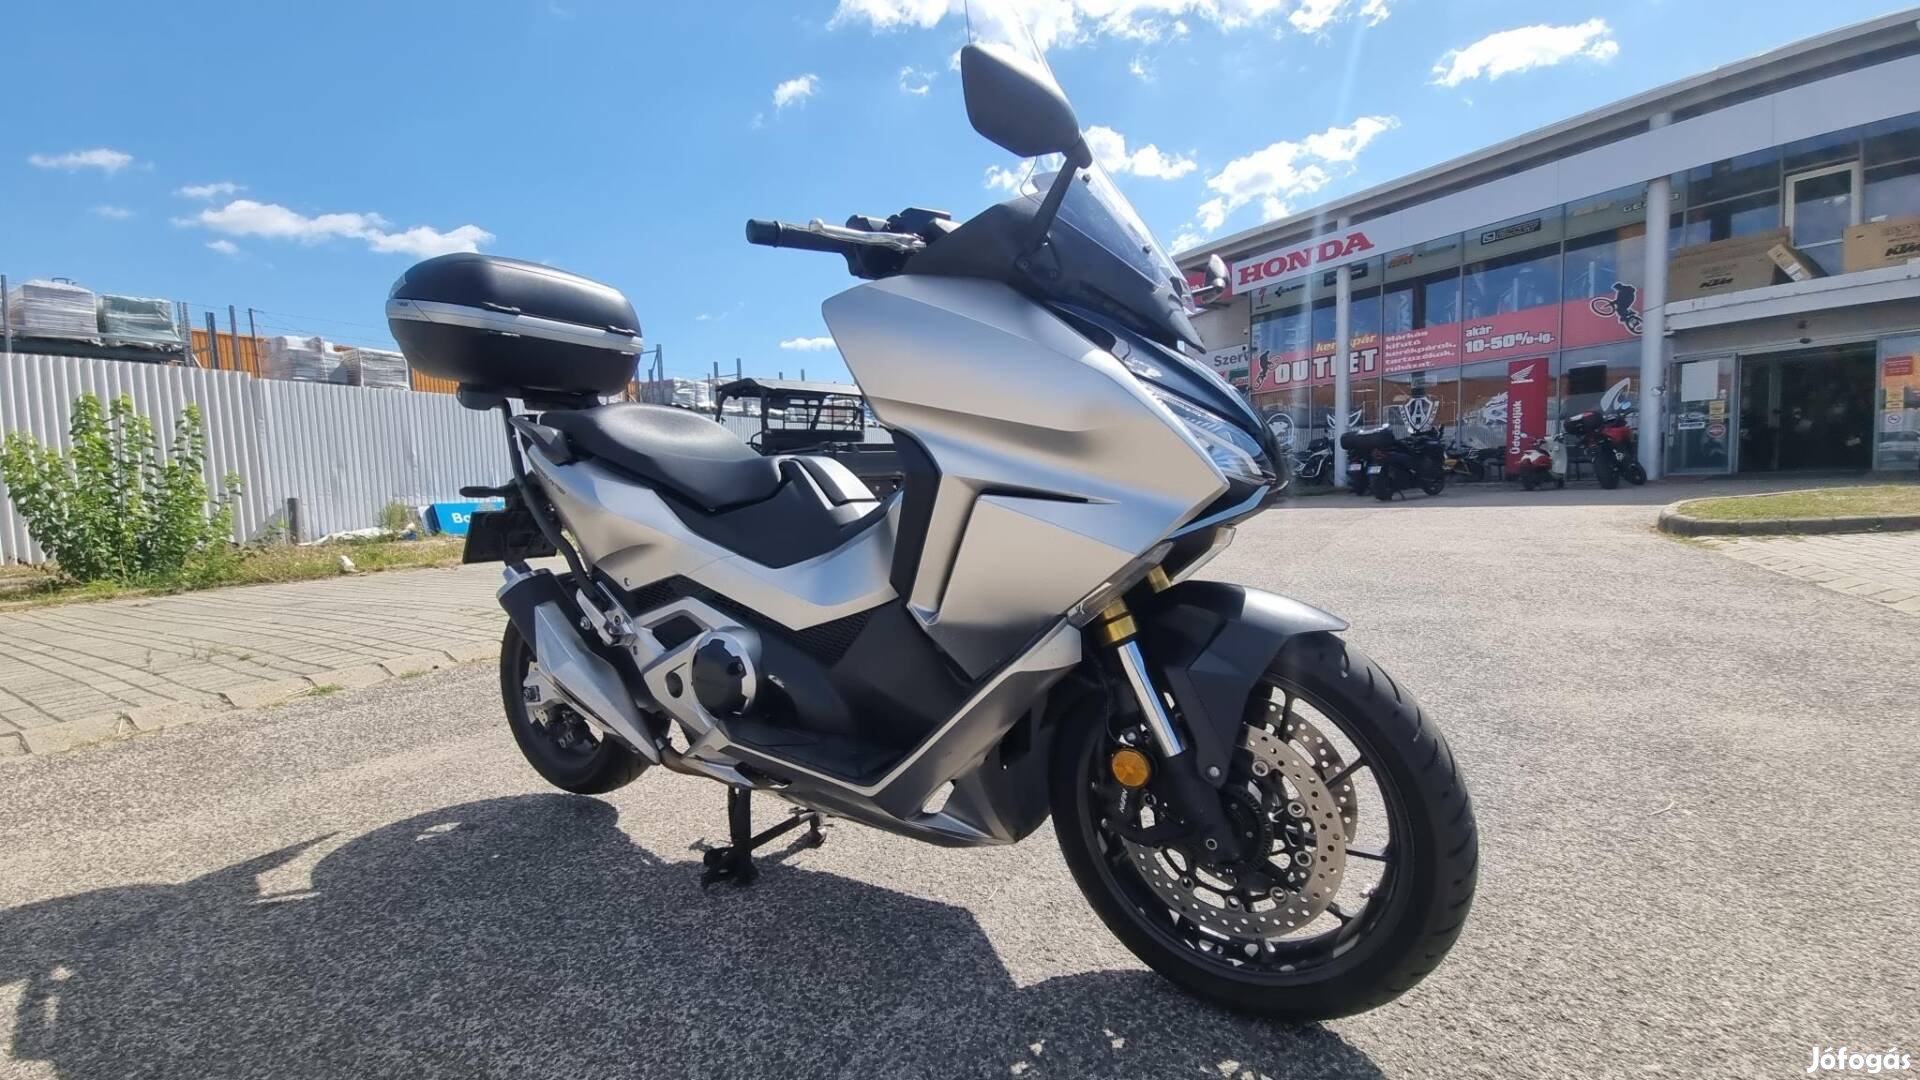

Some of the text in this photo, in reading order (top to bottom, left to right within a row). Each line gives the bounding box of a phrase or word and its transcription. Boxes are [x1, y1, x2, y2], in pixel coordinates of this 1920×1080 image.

[1238, 232, 1375, 286] HONDA
[1315, 333, 1377, 352] kerpár
[1464, 325, 1493, 337] akár
[1509, 400, 1523, 454] Üdvözöljük
